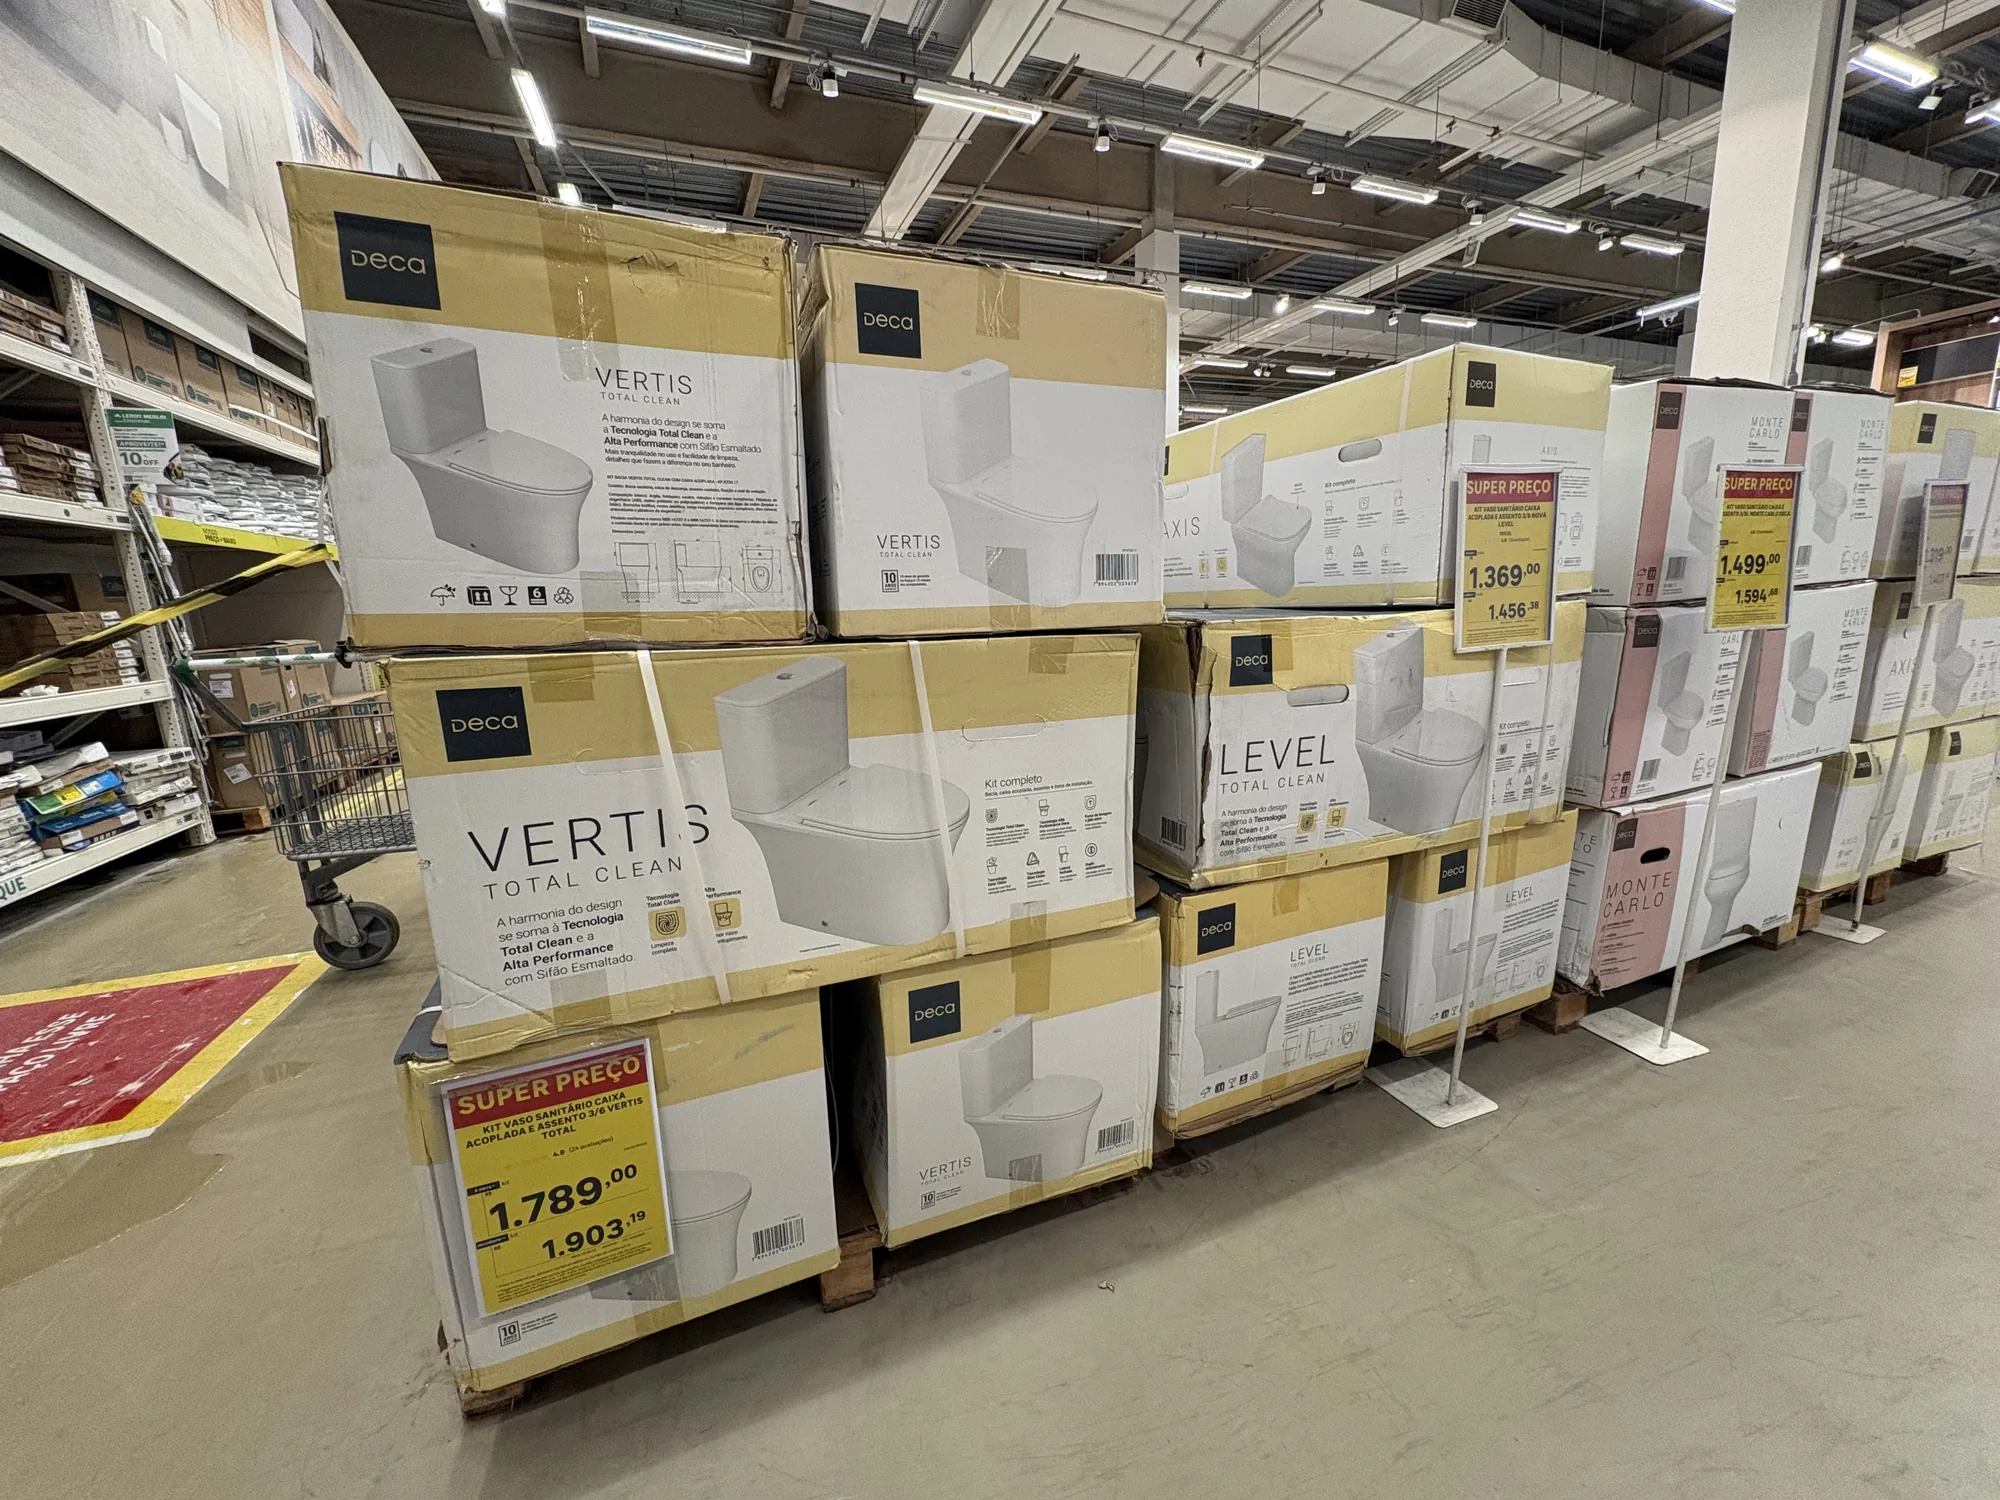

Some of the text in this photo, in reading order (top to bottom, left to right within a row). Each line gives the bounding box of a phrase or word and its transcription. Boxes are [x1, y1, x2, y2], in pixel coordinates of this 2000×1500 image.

[350, 249, 427, 275] Deca
[863, 311, 914, 331] Deca
[595, 367, 692, 394] VERTIS
[1469, 379, 1494, 390] Deca
[600, 391, 680, 406] TOTAL CLEAN
[1660, 405, 1679, 415] Deca
[602, 413, 726, 430] A harmonia do design se soma
[1751, 416, 1784, 427] MONTE
[1860, 419, 1885, 429] MONTE
[610, 425, 657, 437] Tecnologia
[658, 428, 680, 438] Total
[680, 430, 704, 439] Clean
[1749, 427, 1781, 438] CARLO
[1858, 429, 1883, 439] CARLO
[604, 437, 763, 454] Alta Performance com Sifão Esmaltado.
[1540, 446, 1558, 455] AXIS
[119, 451, 142, 466] 10
[1466, 479, 1506, 495] SUPER
[1509, 479, 1551, 497] PREÇO
[1725, 478, 1793, 494] SUPER PREÇO
[1497, 504, 1524, 512] SANITÁRIO
[876, 534, 940, 549] VERTIS
[883, 572, 896, 583] 10
[1843, 607, 1869, 618] MONTE
[1637, 626, 1658, 636] Deca
[1235, 653, 1269, 667] Deca
[451, 713, 519, 733] Deca
[1220, 734, 1335, 776] LEVEL
[985, 774, 1043, 789] Kit completo
[1220, 772, 1325, 795] TOTAL CLEAN
[1227, 807, 1257, 817] harmonia
[1258, 805, 1267, 813] do
[1267, 804, 1288, 812] design
[1253, 813, 1287, 823] Tecnologia
[1238, 826, 1258, 835] Clean
[467, 804, 710, 873] VERTIS
[1220, 833, 1277, 847] Alta Performance
[1219, 849, 1234, 857] com
[1235, 845, 1252, 854] Sifão
[483, 856, 683, 901] TOTAL CLEAN
[1442, 865, 1465, 879] Deca
[1606, 871, 1673, 899] MONTE
[646, 891, 680, 902] Tecnologia
[706, 889, 742, 899] erformance
[1505, 885, 1534, 904] LEVEL
[646, 898, 681, 908] Total Clean
[1603, 892, 1664, 918] CARLO
[496, 899, 623, 928] A harmonia do design
[498, 913, 624, 943] se soma à Tecnologia
[1201, 921, 1232, 937] Deca
[500, 932, 595, 957] Total Clean e a
[650, 941, 675, 949] Limpeza
[651, 946, 678, 956] completa
[1290, 942, 1329, 962] LEVEL
[502, 943, 614, 972] Alta Performance
[504, 953, 636, 986] com Sifão Esmaltado.
[914, 1002, 956, 1021] Deca
[456, 1055, 641, 1116] SUPER PREÇO
[482, 1091, 626, 1134] KIT VASO SANITÁRIO CAIXA
[465, 1096, 644, 1149] ACOPLADA E ASSENTO 3/6 VERTIS
[540, 1124, 577, 1140] TOTAL
[552, 1149, 565, 1158] 4.9
[919, 1156, 971, 1180] VERTIS
[920, 1170, 964, 1187] TOTAL CLEAN
[923, 1193, 934, 1203] 10
[501, 1324, 517, 1337] 10
